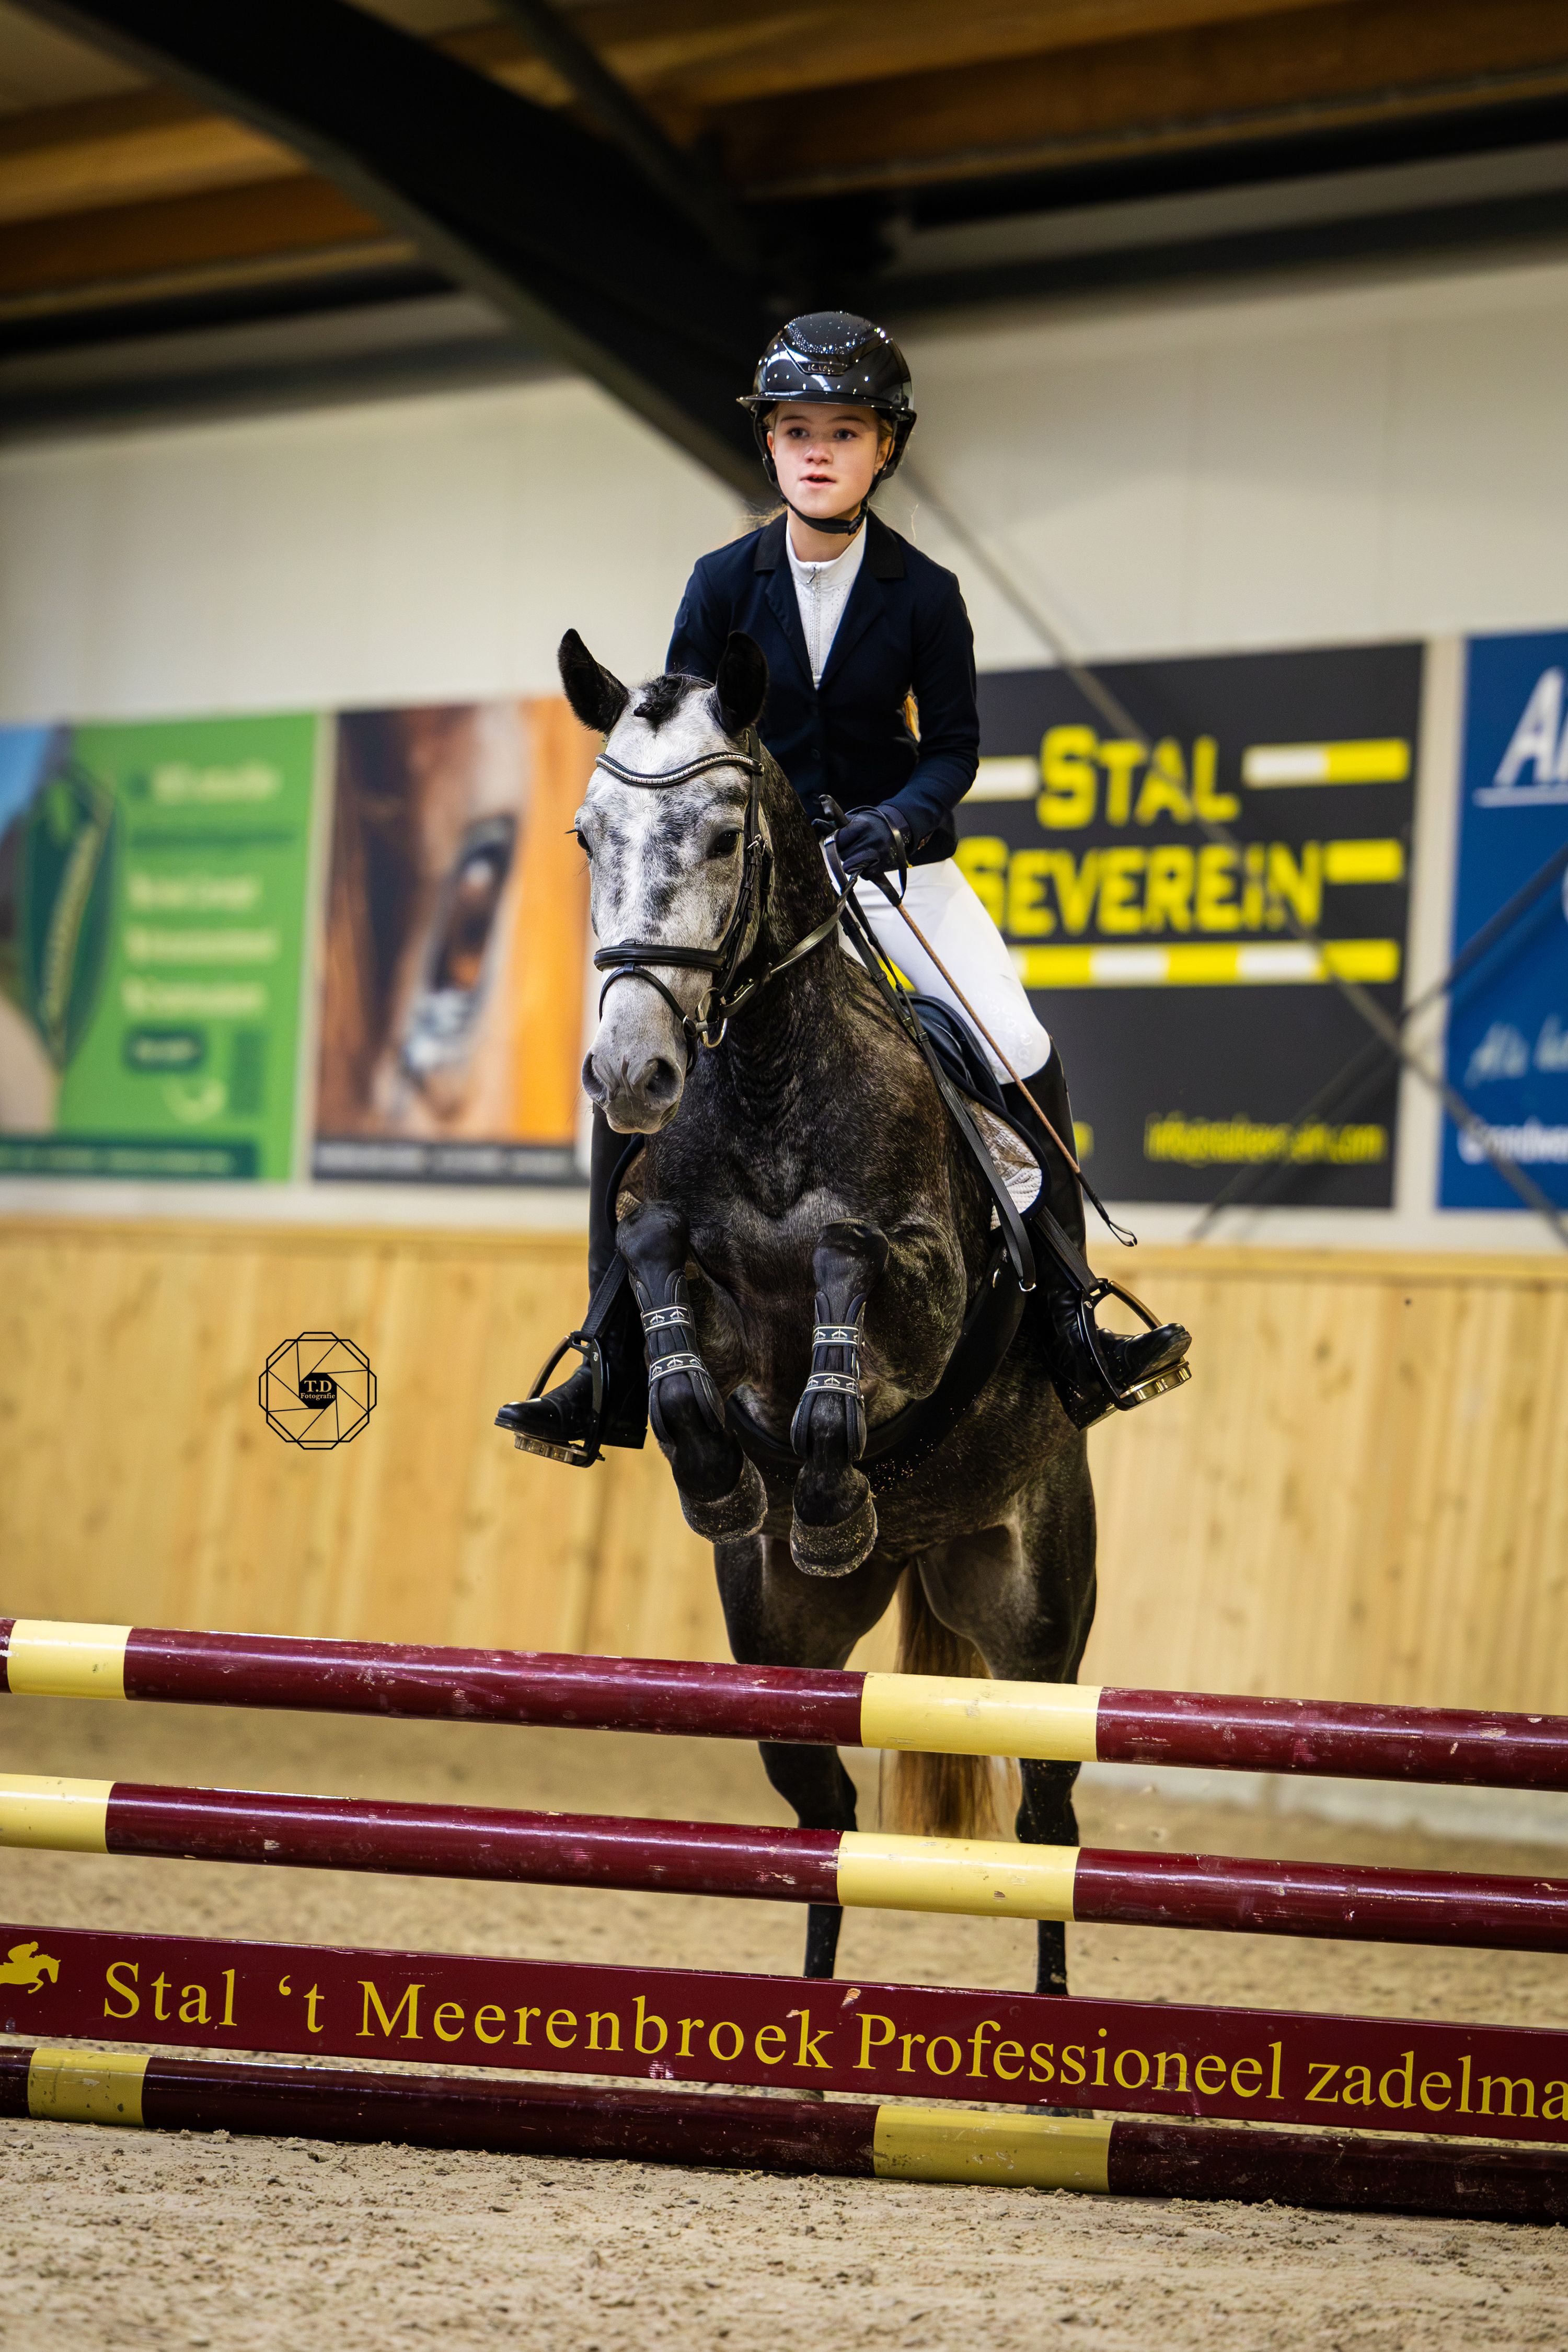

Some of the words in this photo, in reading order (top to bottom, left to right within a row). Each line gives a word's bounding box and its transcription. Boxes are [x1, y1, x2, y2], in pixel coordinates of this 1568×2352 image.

[104, 1962, 237, 2026] Stal
[356, 1980, 834, 2069] Meerenbroek
[853, 2013, 1285, 2100] Professioneel
[1305, 2050, 1568, 2121] zadelma
